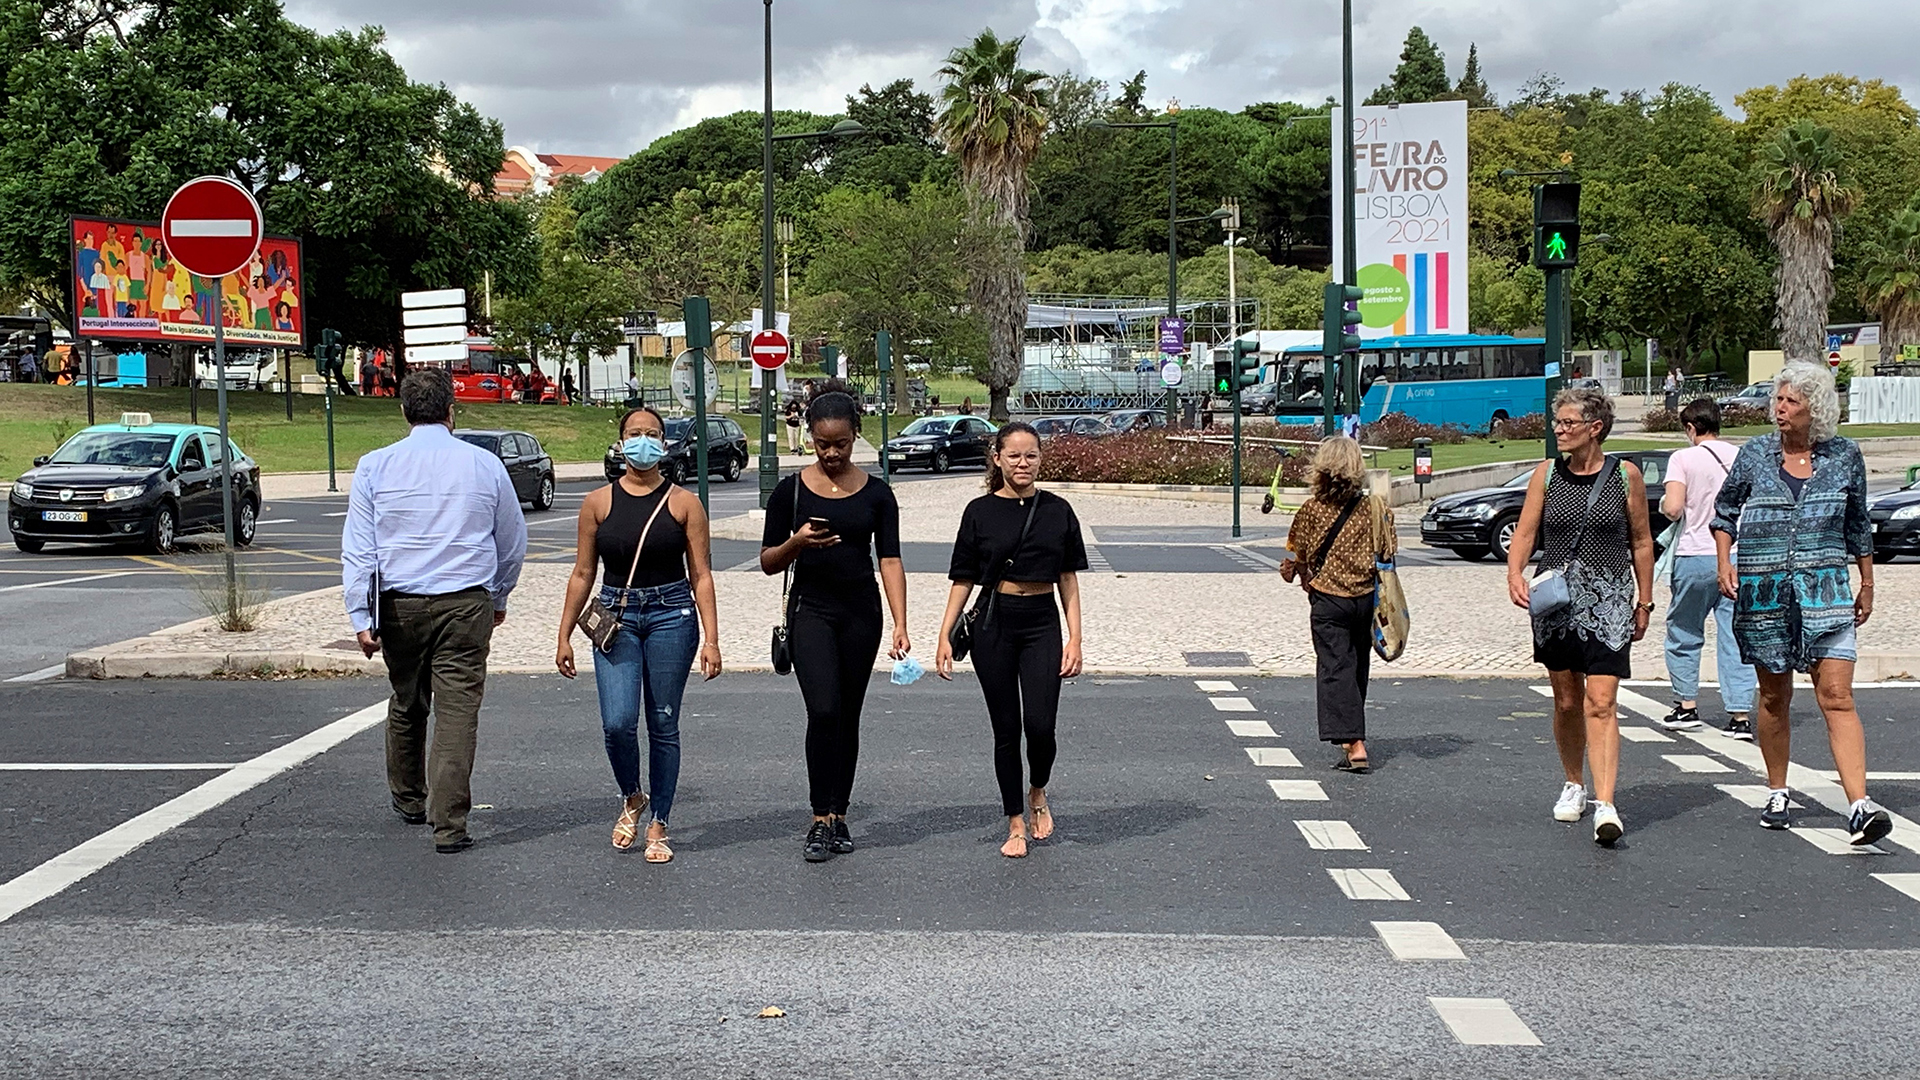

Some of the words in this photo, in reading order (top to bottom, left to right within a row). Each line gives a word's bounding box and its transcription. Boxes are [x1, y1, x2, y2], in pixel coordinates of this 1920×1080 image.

[1386, 218, 1450, 243] 2021
[1363, 295, 1404, 304] setembro
[82, 319, 109, 328] Portugal
[163, 325, 177, 333] Mais
